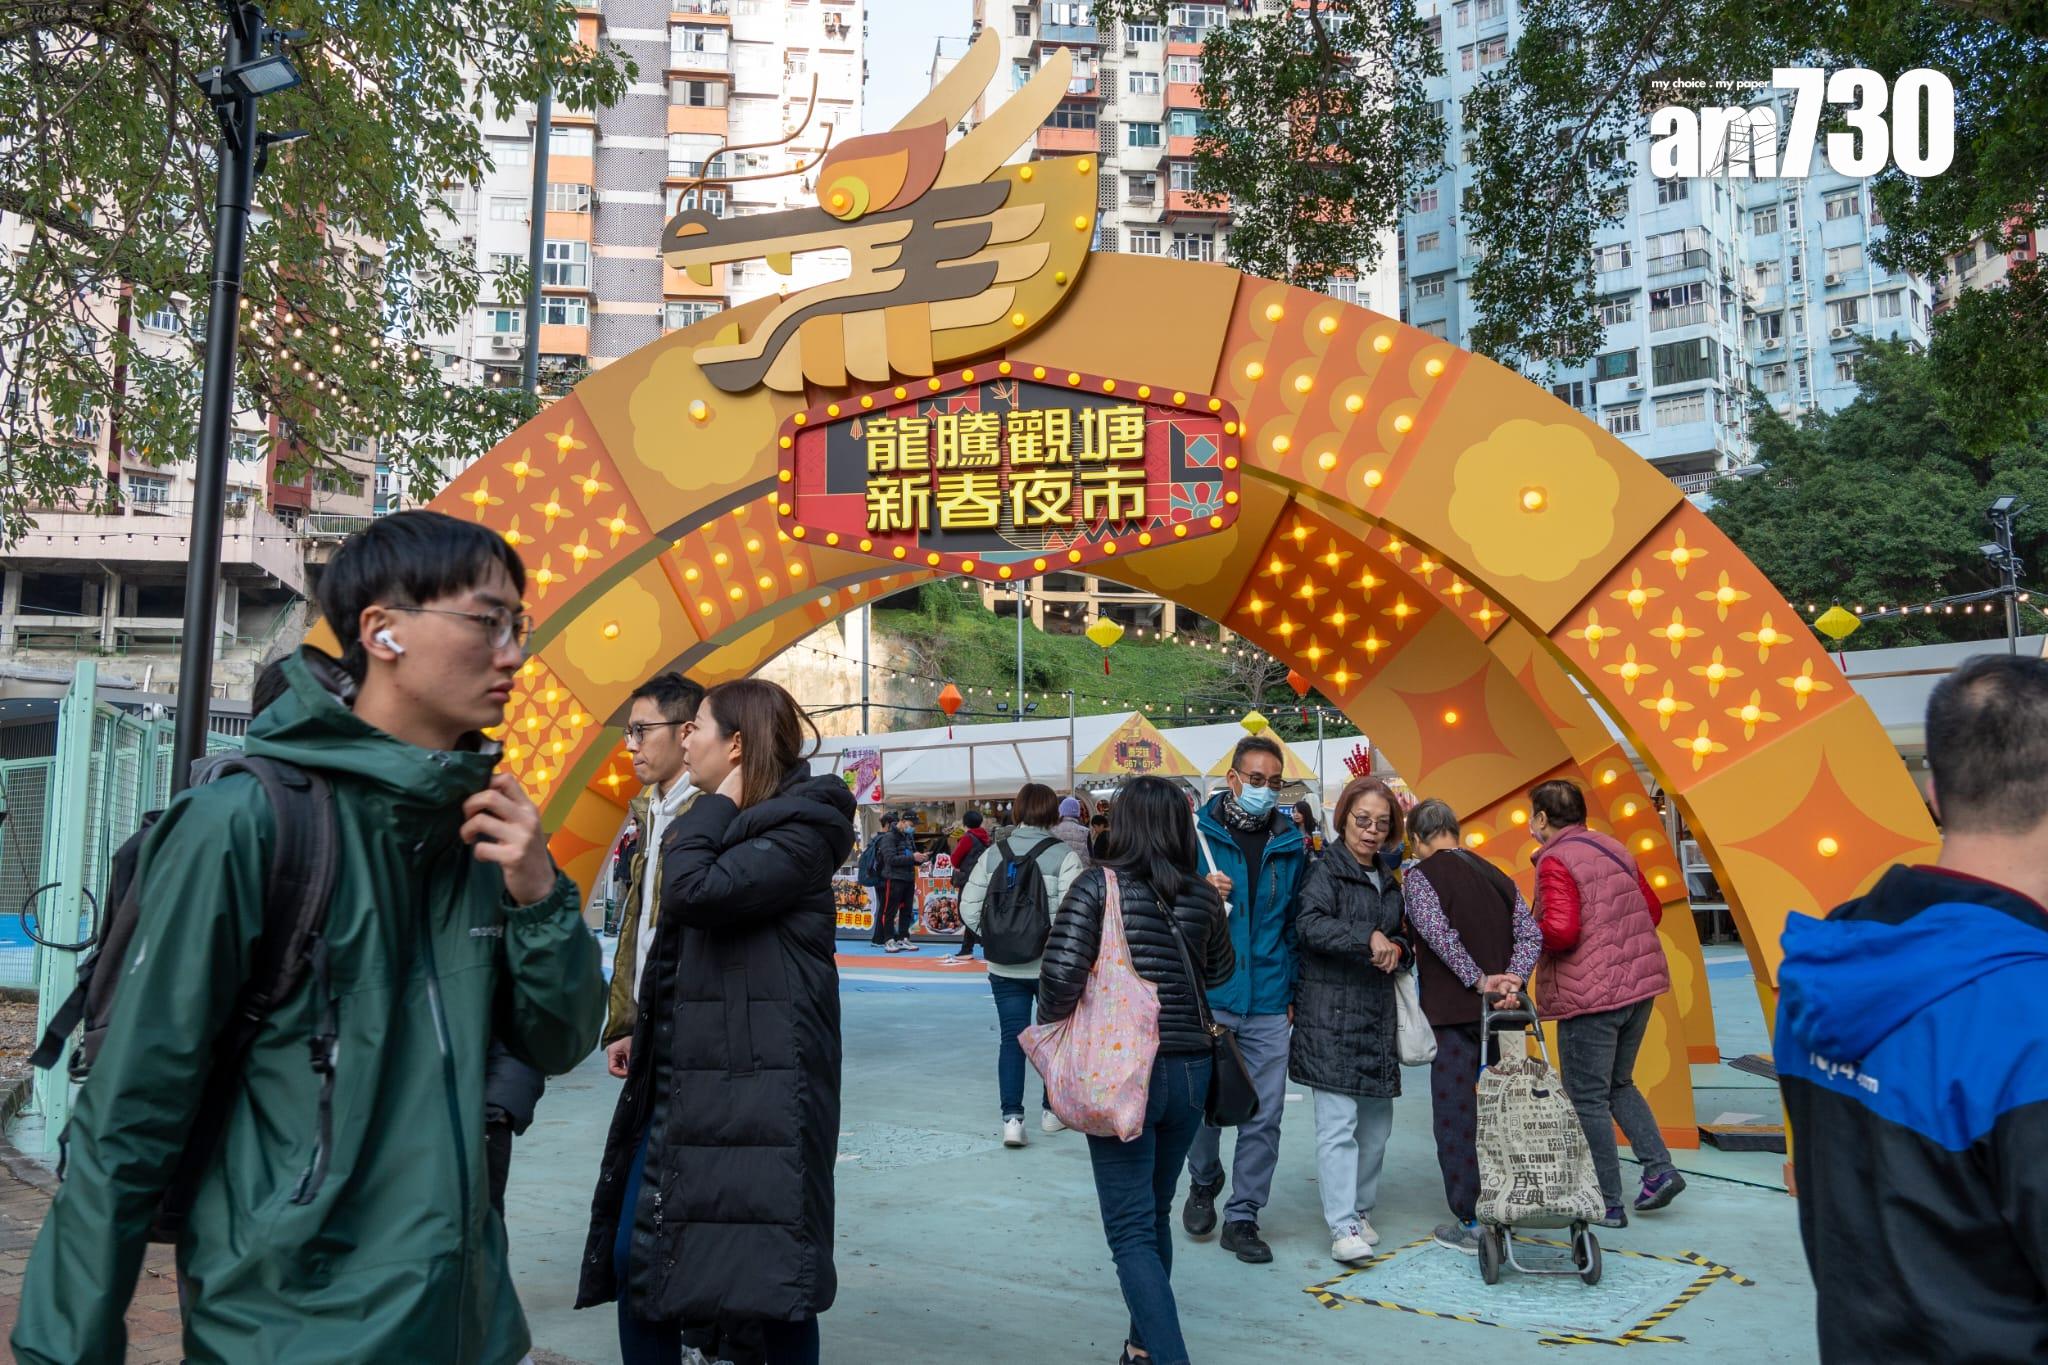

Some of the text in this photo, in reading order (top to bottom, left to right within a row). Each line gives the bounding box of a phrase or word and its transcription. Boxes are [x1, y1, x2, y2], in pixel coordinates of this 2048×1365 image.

[866, 405, 1146, 472] 龍騰觀塘
[866, 467, 1146, 531] 新春夜市
[1523, 1121, 1537, 1130] SOY
[1539, 1120, 1559, 1130] SAUCE
[1528, 1153, 1556, 1163] CHUN
[1512, 1171, 1544, 1189] 百年
[1506, 1189, 1546, 1208] 經典
